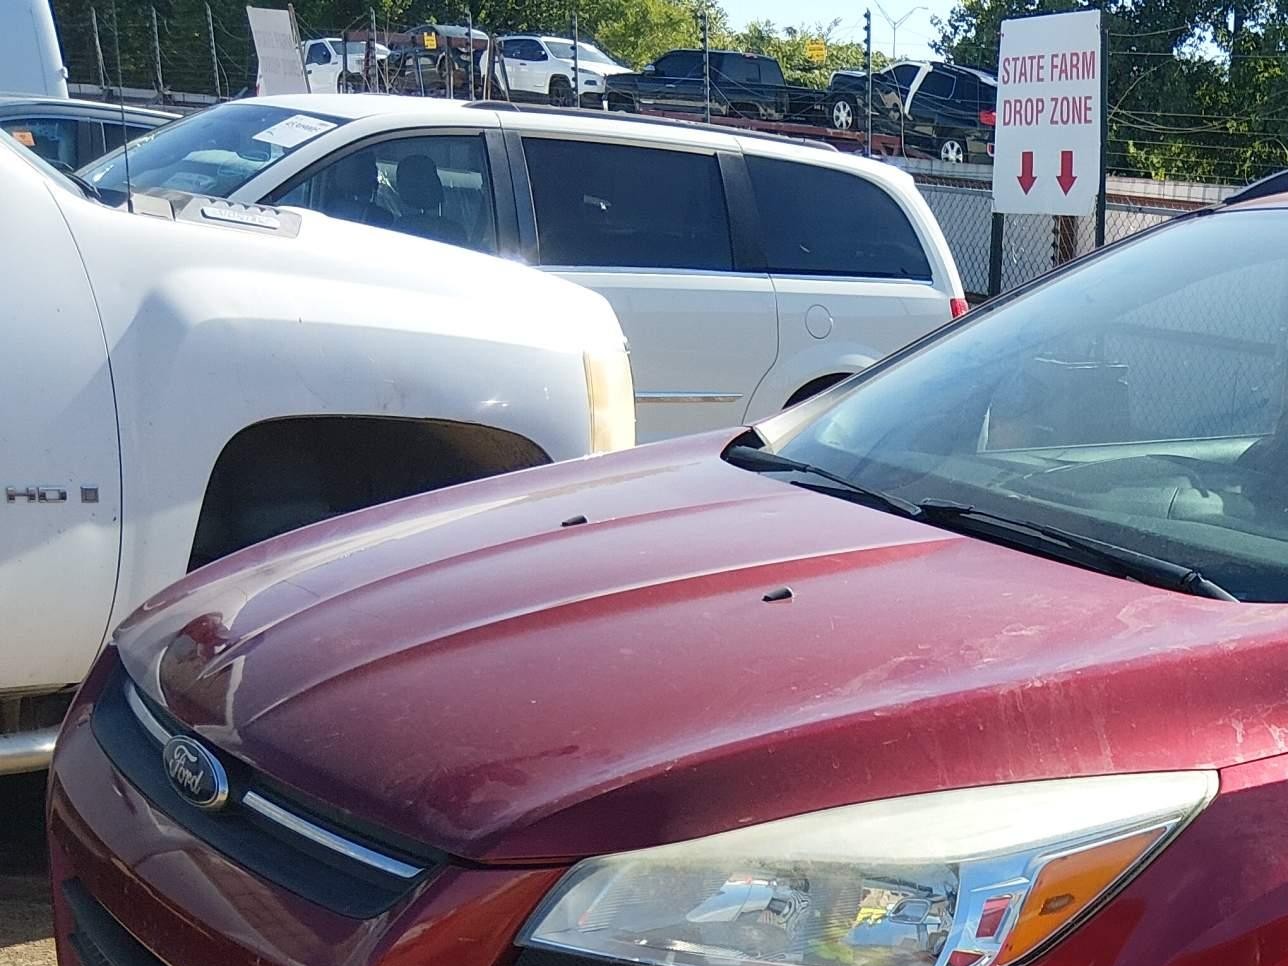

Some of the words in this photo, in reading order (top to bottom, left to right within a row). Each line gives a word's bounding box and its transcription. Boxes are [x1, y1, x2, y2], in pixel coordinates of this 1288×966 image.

[1002, 55, 1045, 85] STATE
[1050, 51, 1096, 82] FARM
[1003, 98, 1045, 126] DROP
[1050, 96, 1093, 125] ZONE
[169, 744, 204, 795] Ford
